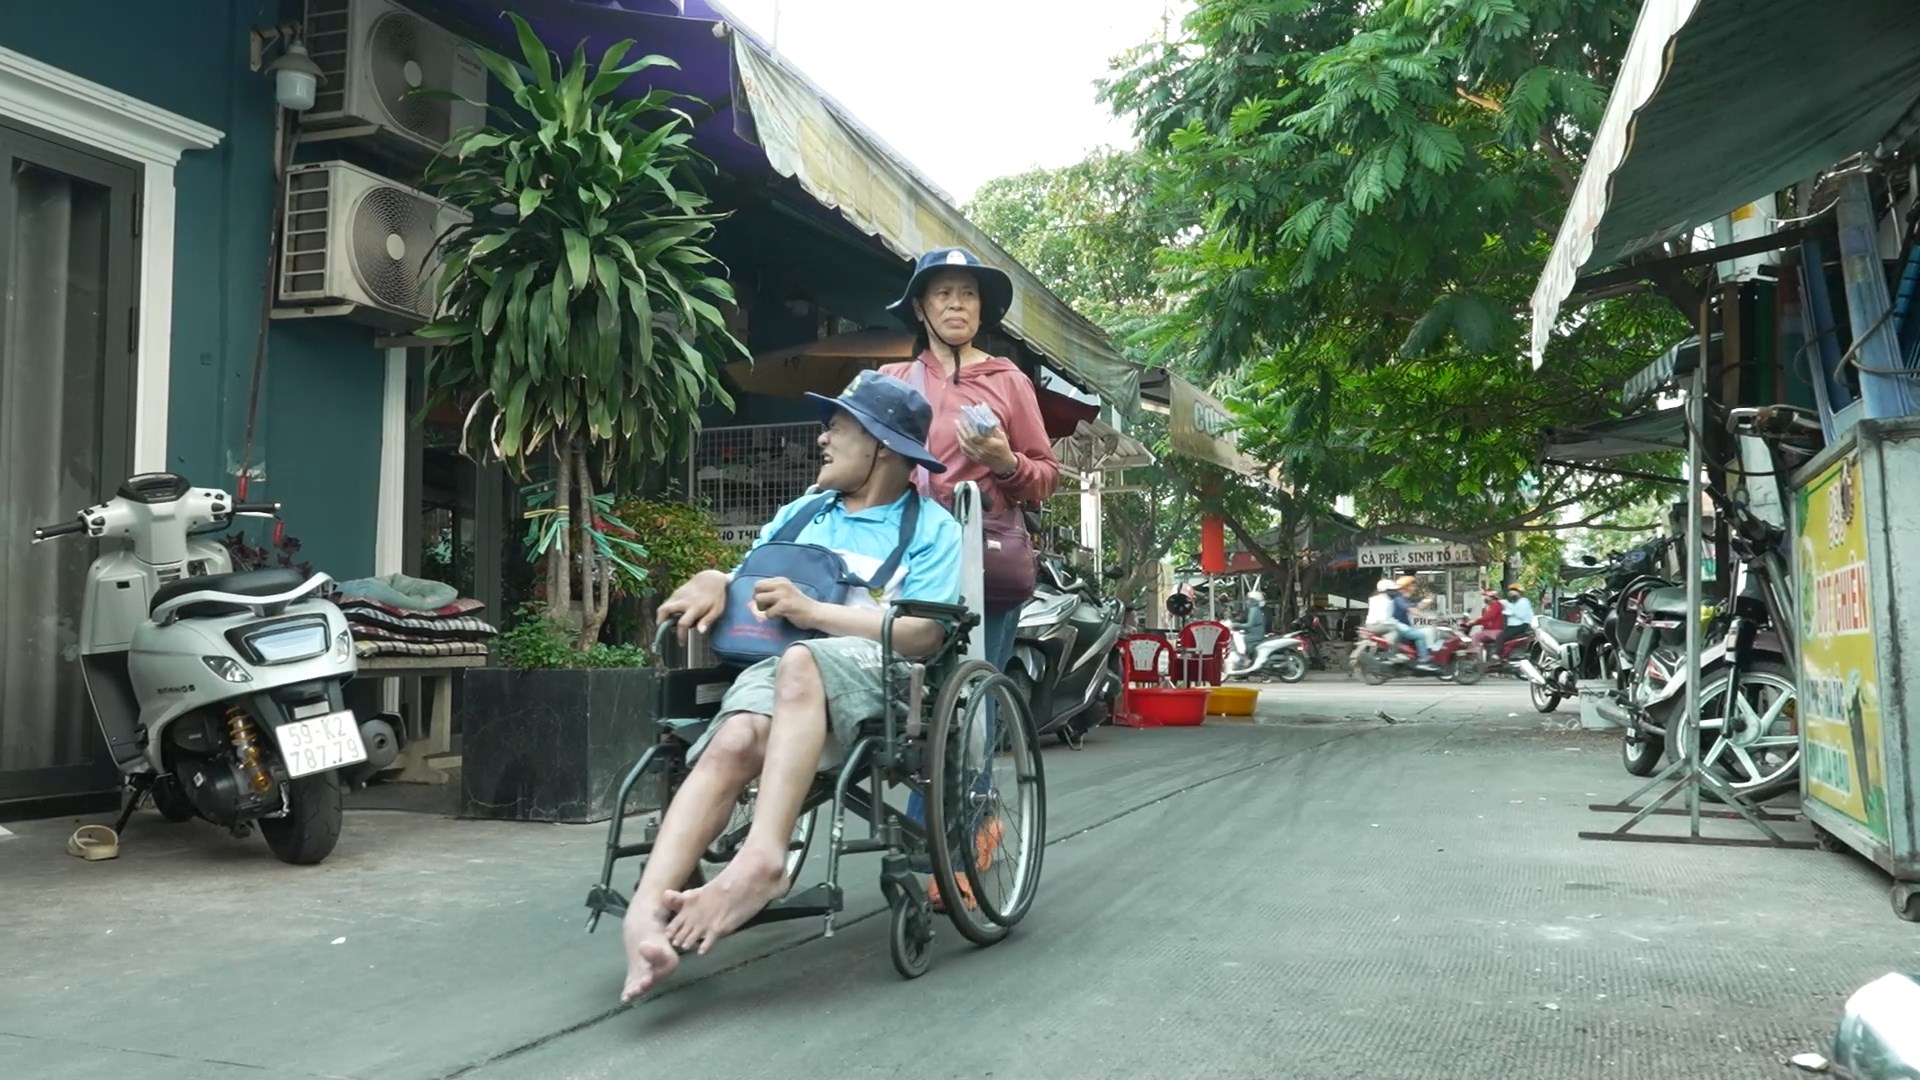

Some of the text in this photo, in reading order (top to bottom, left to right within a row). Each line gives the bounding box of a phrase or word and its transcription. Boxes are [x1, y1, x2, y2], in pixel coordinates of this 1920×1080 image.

[1361, 550, 1376, 565] CÀ
[1407, 551, 1434, 563] SINH
[1436, 545, 1451, 561] TỐ
[287, 717, 347, 747] 59-K2
[289, 739, 360, 774] 787.79
